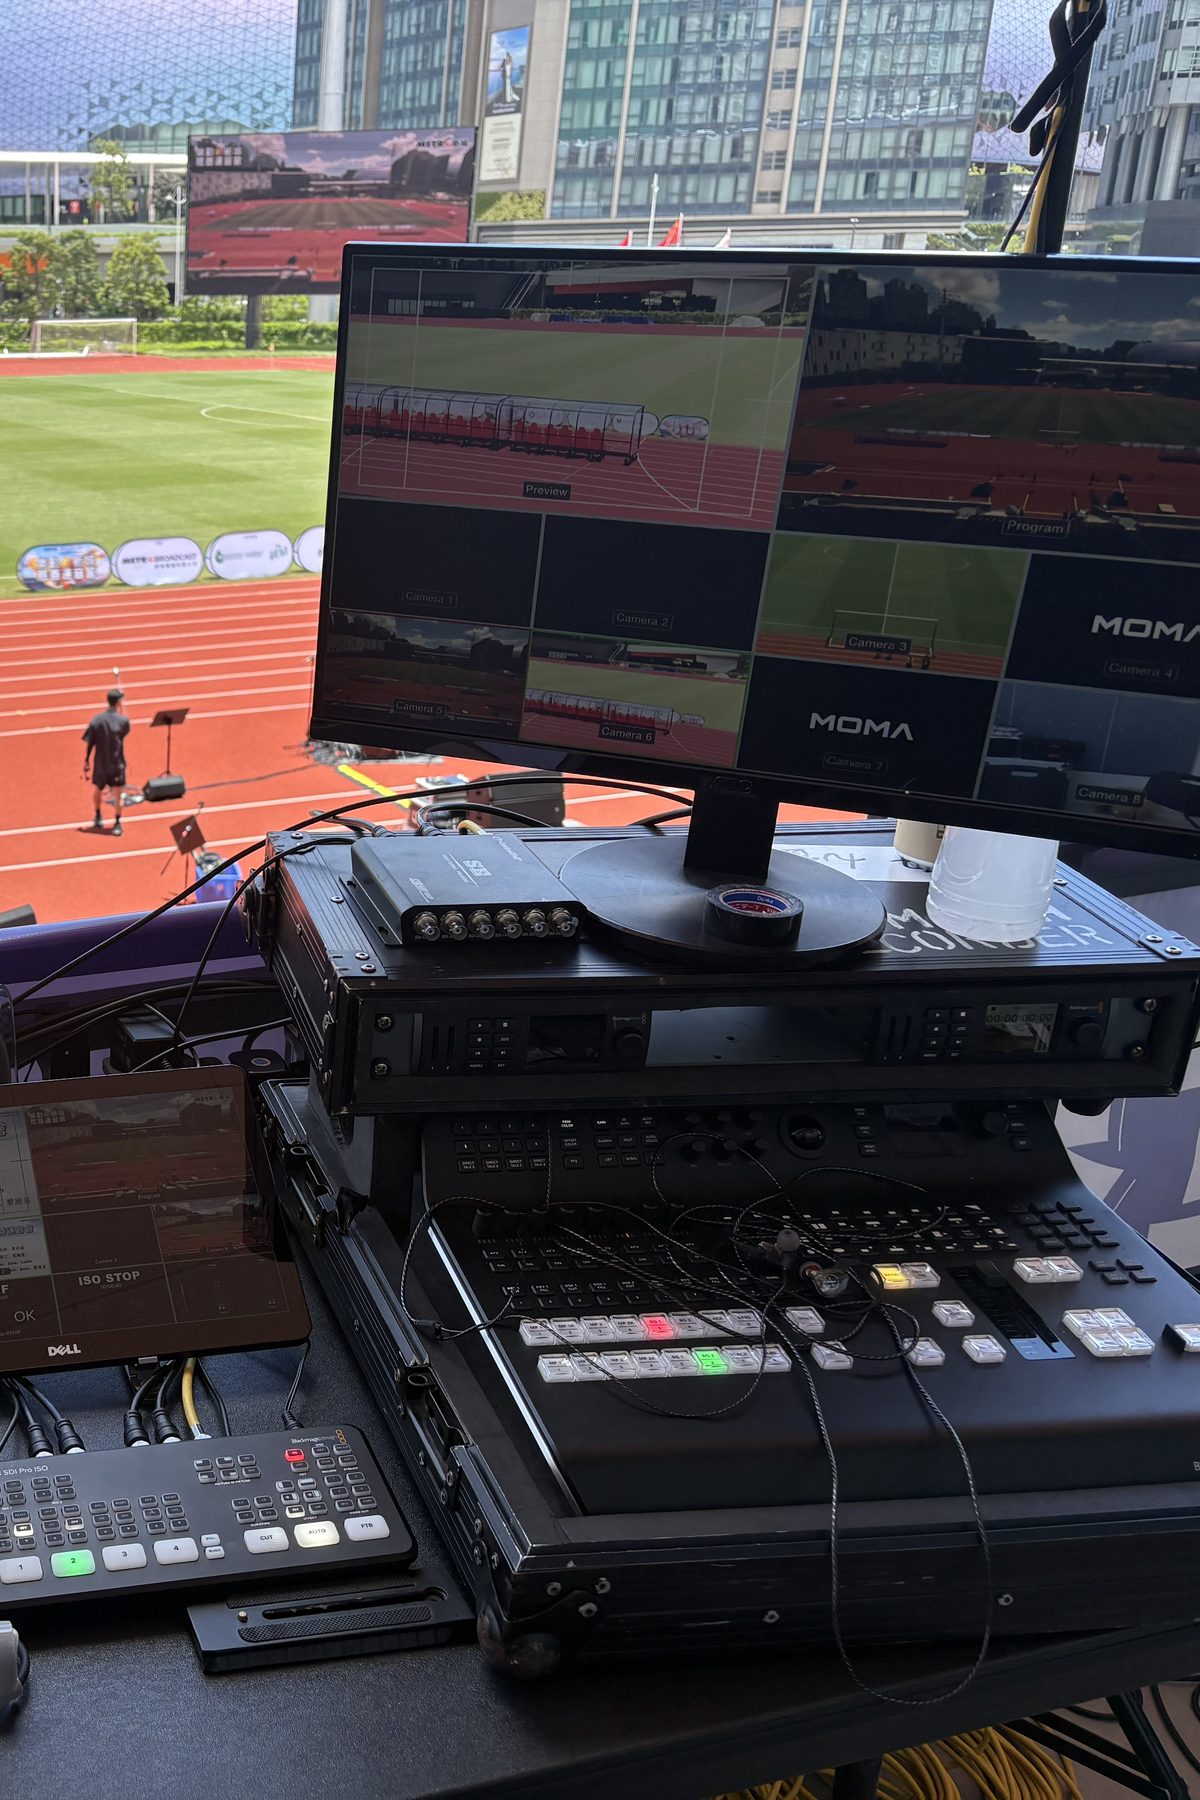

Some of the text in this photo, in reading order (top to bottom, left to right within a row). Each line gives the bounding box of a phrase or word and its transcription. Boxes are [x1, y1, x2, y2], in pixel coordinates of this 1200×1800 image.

[526, 485, 569, 498] Preview
[1006, 519, 1065, 537] Program
[404, 591, 444, 604] Camera
[616, 612, 670, 627] Camera 2
[1090, 614, 1200, 643] MOMA
[848, 636, 907, 651] Camera 3
[1108, 662, 1174, 679] Camera 4
[395, 700, 443, 715] Camera 5
[601, 726, 653, 741] Camera 6
[809, 712, 914, 742] MOMA
[825, 755, 885, 771] Camera 7
[1078, 787, 1142, 804] Camera 8
[986, 1012, 1054, 1025] 00:00:00:00
[78, 1271, 141, 1287] ISO STOP
[13, 1309, 37, 1323] OK
[47, 1343, 83, 1357] DELL
[3, 1468, 18, 1478] SDI
[18, 1466, 33, 1476] Pro
[33, 1465, 49, 1475] ISO
[308, 1528, 328, 1536] AUTO
[361, 1521, 374, 1530] FTB
[259, 1534, 274, 1543] CUT
